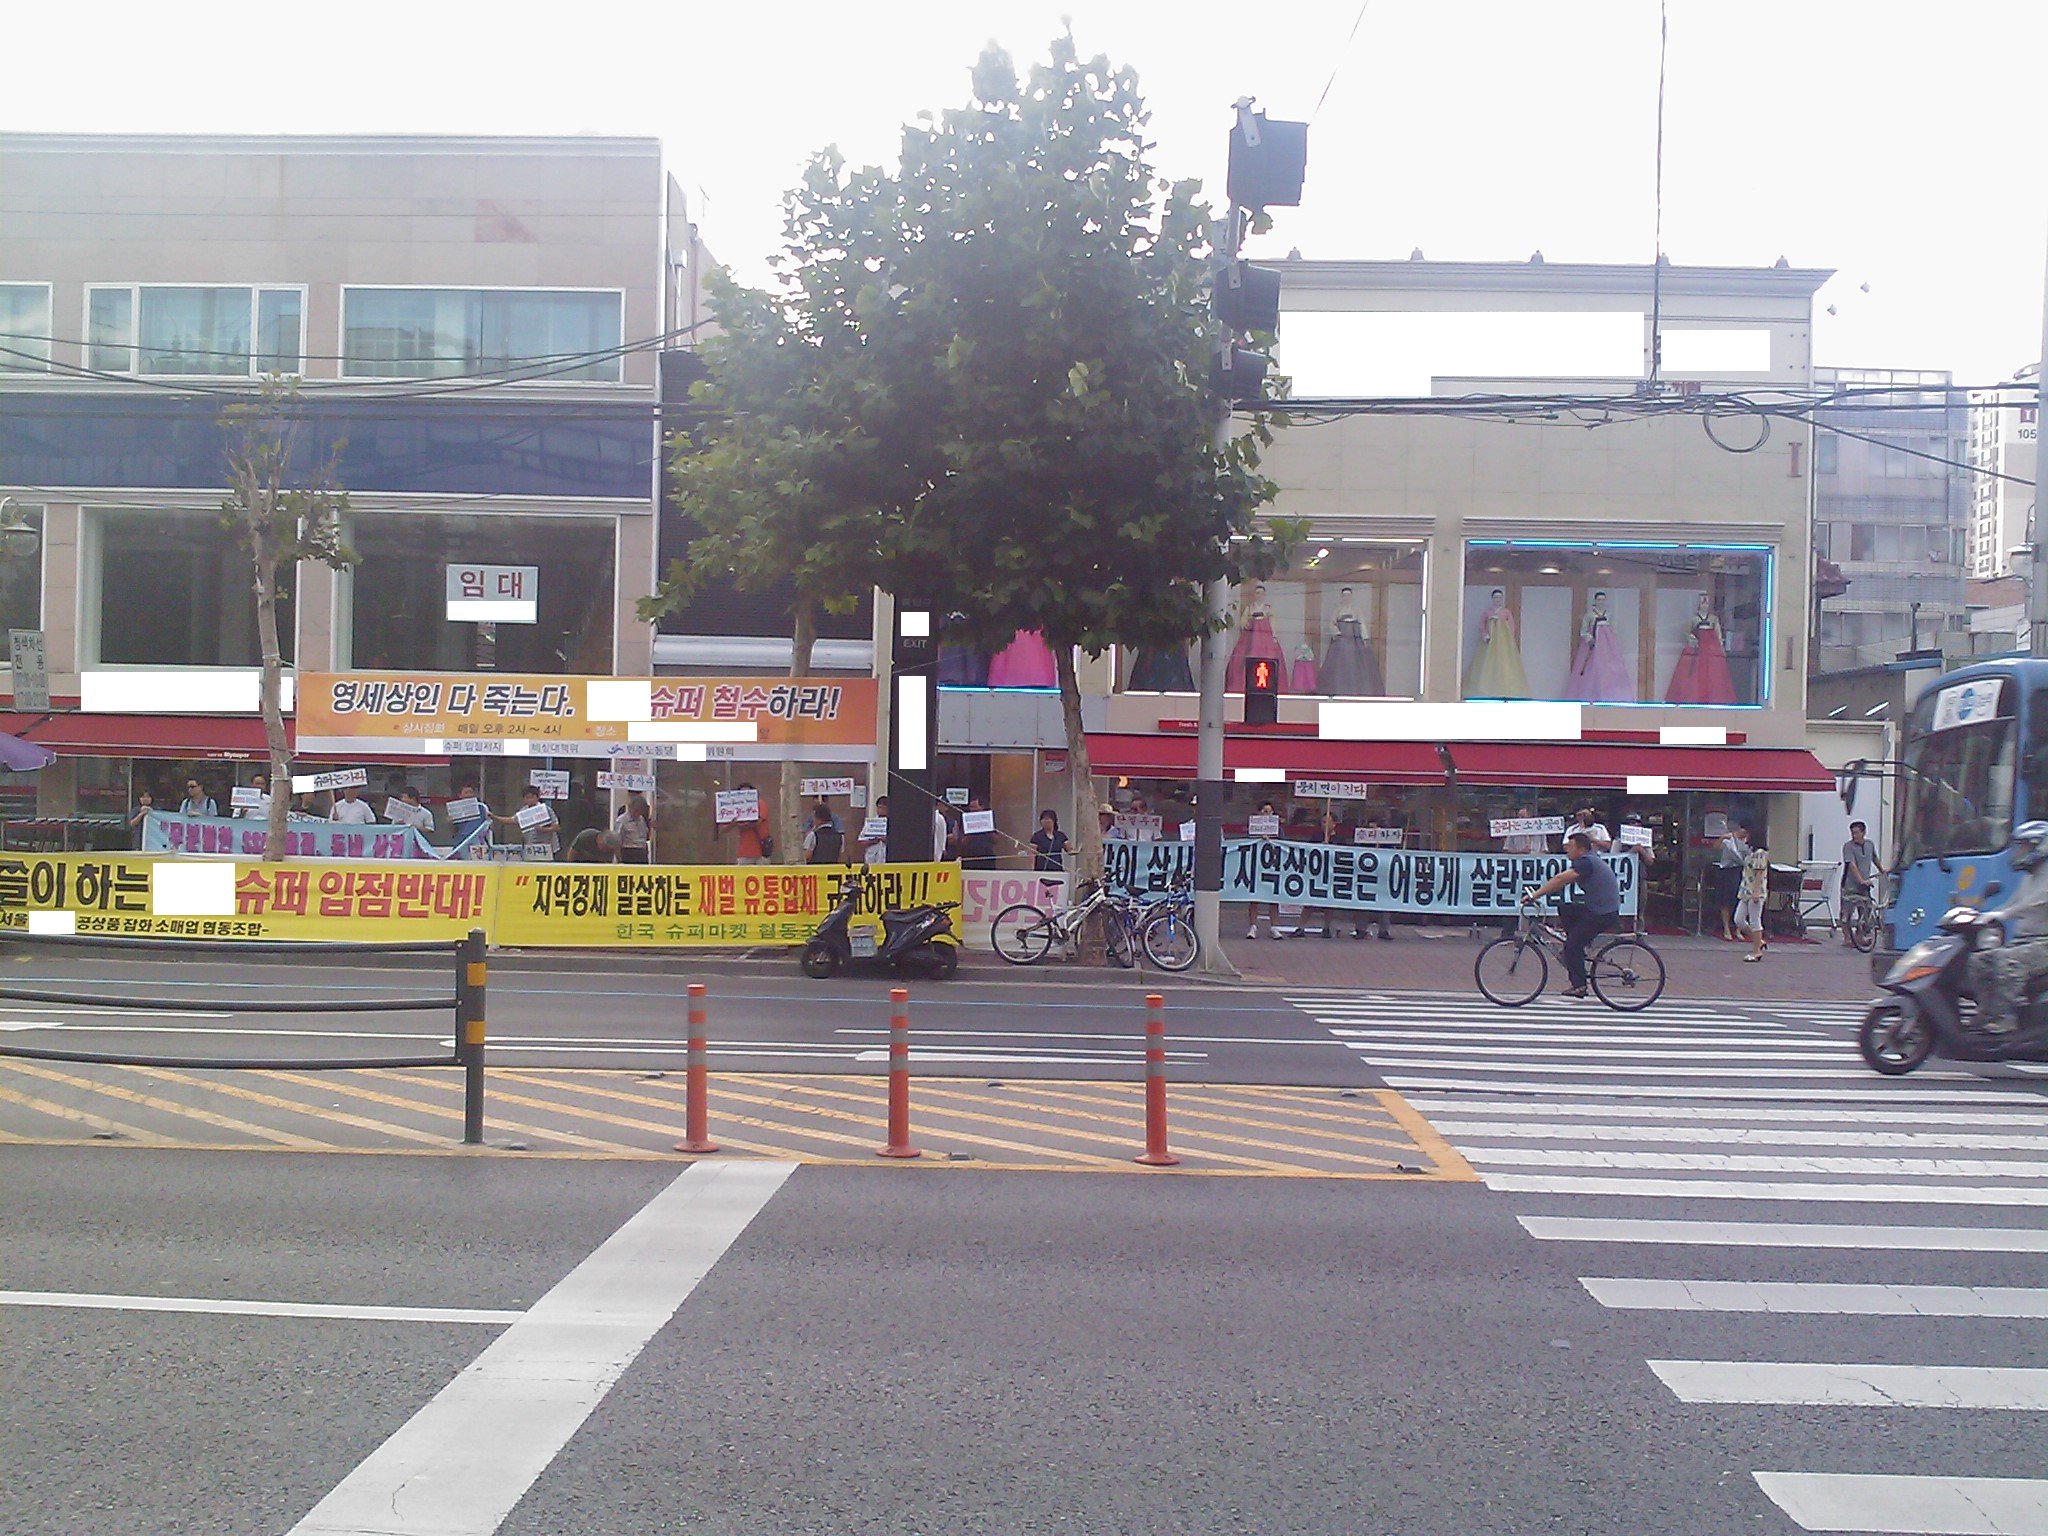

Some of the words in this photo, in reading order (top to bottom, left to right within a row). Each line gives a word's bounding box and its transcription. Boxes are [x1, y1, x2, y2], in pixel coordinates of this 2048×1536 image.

[2017, 428, 2037, 440] 105
[903, 638, 928, 649] EXIT
[332, 681, 440, 715] 영세상인
[447, 682, 476, 716] 다
[483, 682, 575, 717] 죽는다.
[650, 685, 705, 718] 슈퍼
[712, 685, 841, 720] 철수하라!
[1233, 842, 1379, 902] 지역상인들은
[1388, 852, 1460, 908] 어떻게
[75, 862, 149, 911] 하는
[235, 869, 311, 916] 슈퍼
[319, 871, 486, 919] 입점반대!
[617, 875, 690, 916] 말살하는
[698, 874, 736, 916] 재벌
[744, 874, 818, 916] 유통업체
[77, 915, 121, 931] 공상품
[123, 917, 152, 933] 잡화
[155, 919, 200, 935] 소매업
[616, 922, 656, 940] 한국
[665, 922, 748, 940] 슈퍼마켓
[758, 923, 819, 940] 협동조
